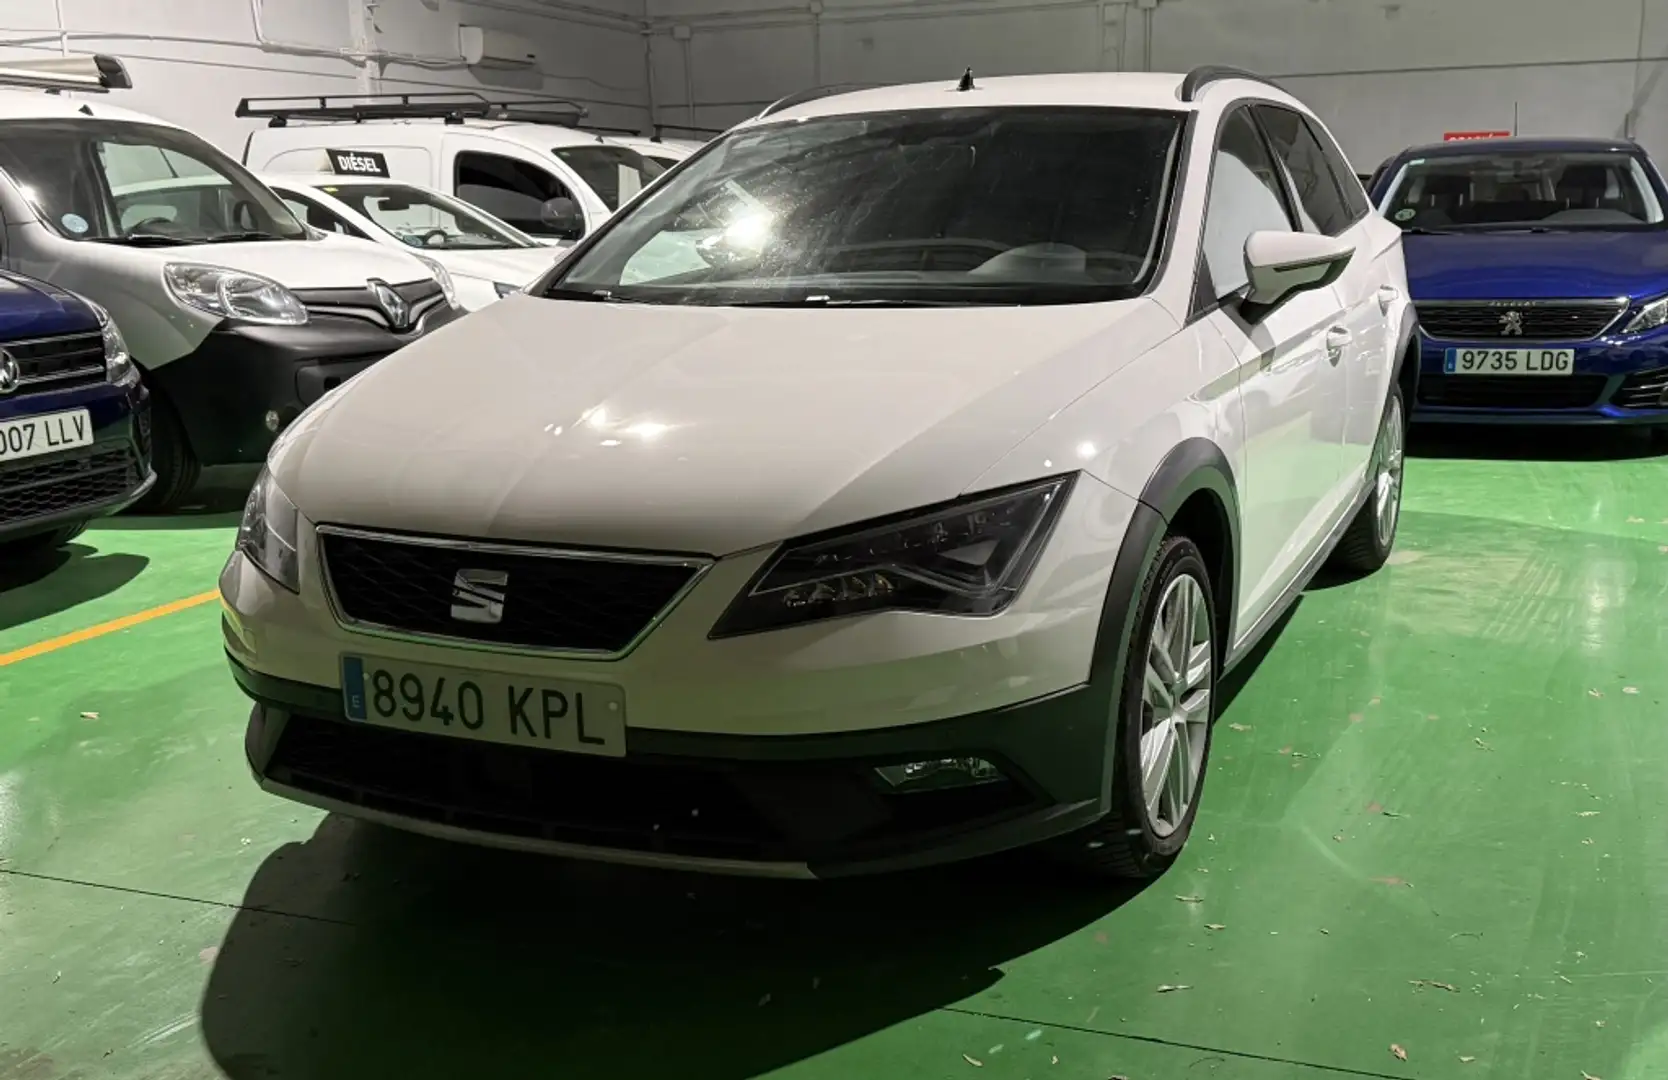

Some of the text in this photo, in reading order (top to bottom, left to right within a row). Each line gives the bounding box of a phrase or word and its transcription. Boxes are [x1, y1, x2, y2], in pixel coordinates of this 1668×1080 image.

[337, 152, 382, 173] DIÉSEL
[1462, 351, 1569, 371] 9735 LDG
[44, 414, 84, 446] LLV
[372, 669, 606, 746] 8940 KPL
